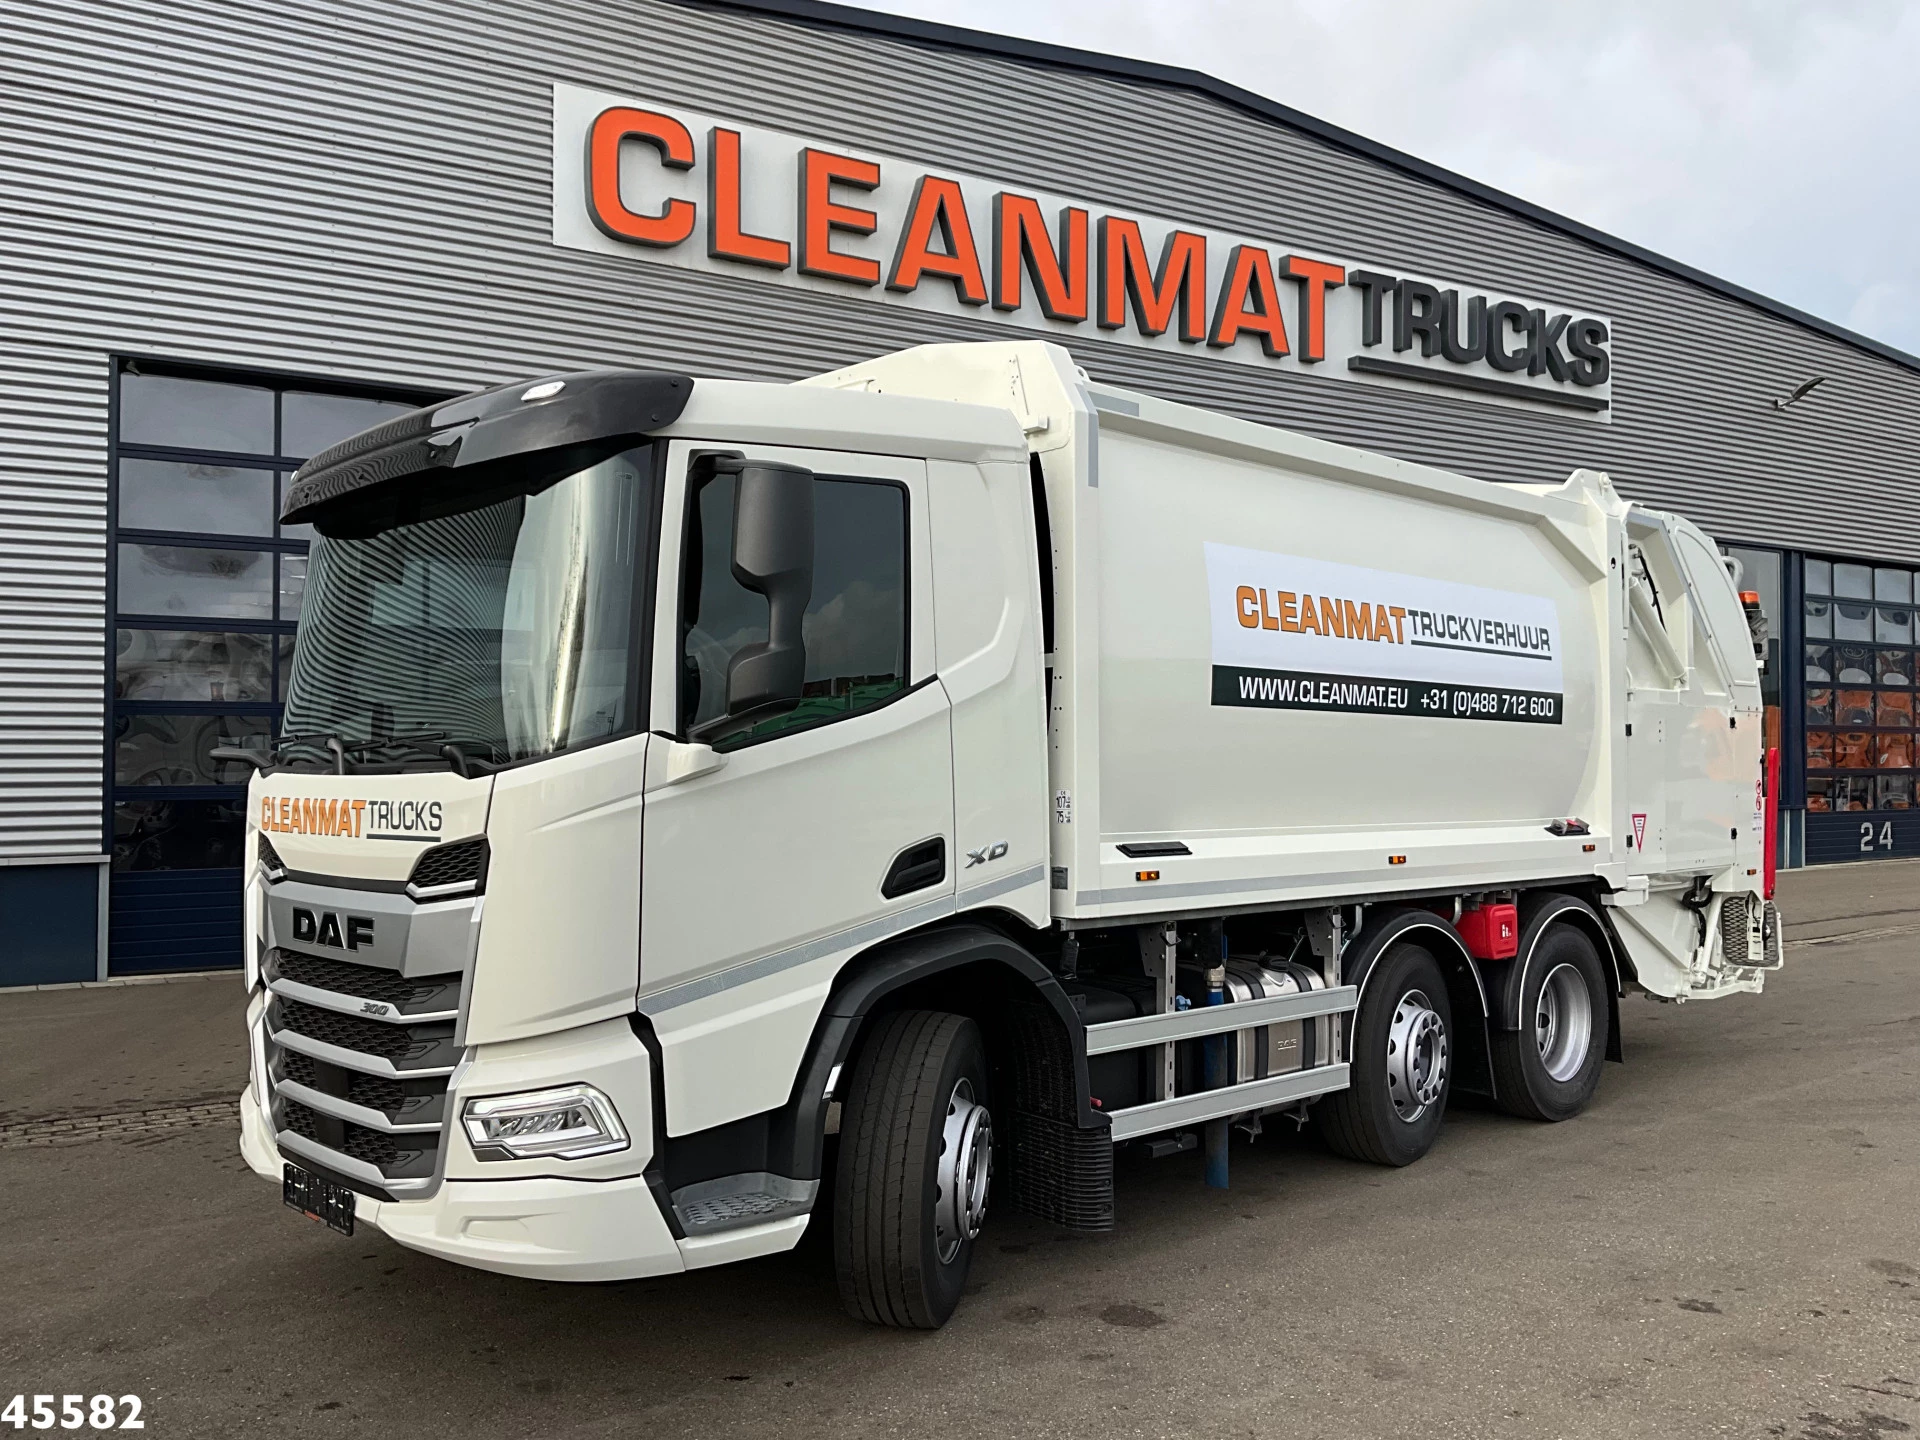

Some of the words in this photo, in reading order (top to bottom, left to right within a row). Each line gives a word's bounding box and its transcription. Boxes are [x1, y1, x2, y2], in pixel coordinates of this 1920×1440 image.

[585, 105, 1345, 364] CLEANMAT
[1348, 269, 1609, 386] TRUCKS
[1236, 585, 1406, 644] CLEANMAT
[1407, 609, 1551, 651] TRUCKVERHUUR
[1238, 675, 1408, 709] WWW.CLEANMAT.EU
[1420, 688, 1448, 710] +31
[1453, 691, 1498, 715] (0)488
[1502, 694, 1527, 715] 712
[1530, 696, 1554, 717] 600
[262, 796, 366, 837] CLEANMAT
[367, 800, 443, 831] TRUCKS
[1860, 821, 1893, 852] 24
[964, 840, 1009, 869] XD
[292, 906, 375, 953] DAF
[360, 1002, 390, 1016] 300
